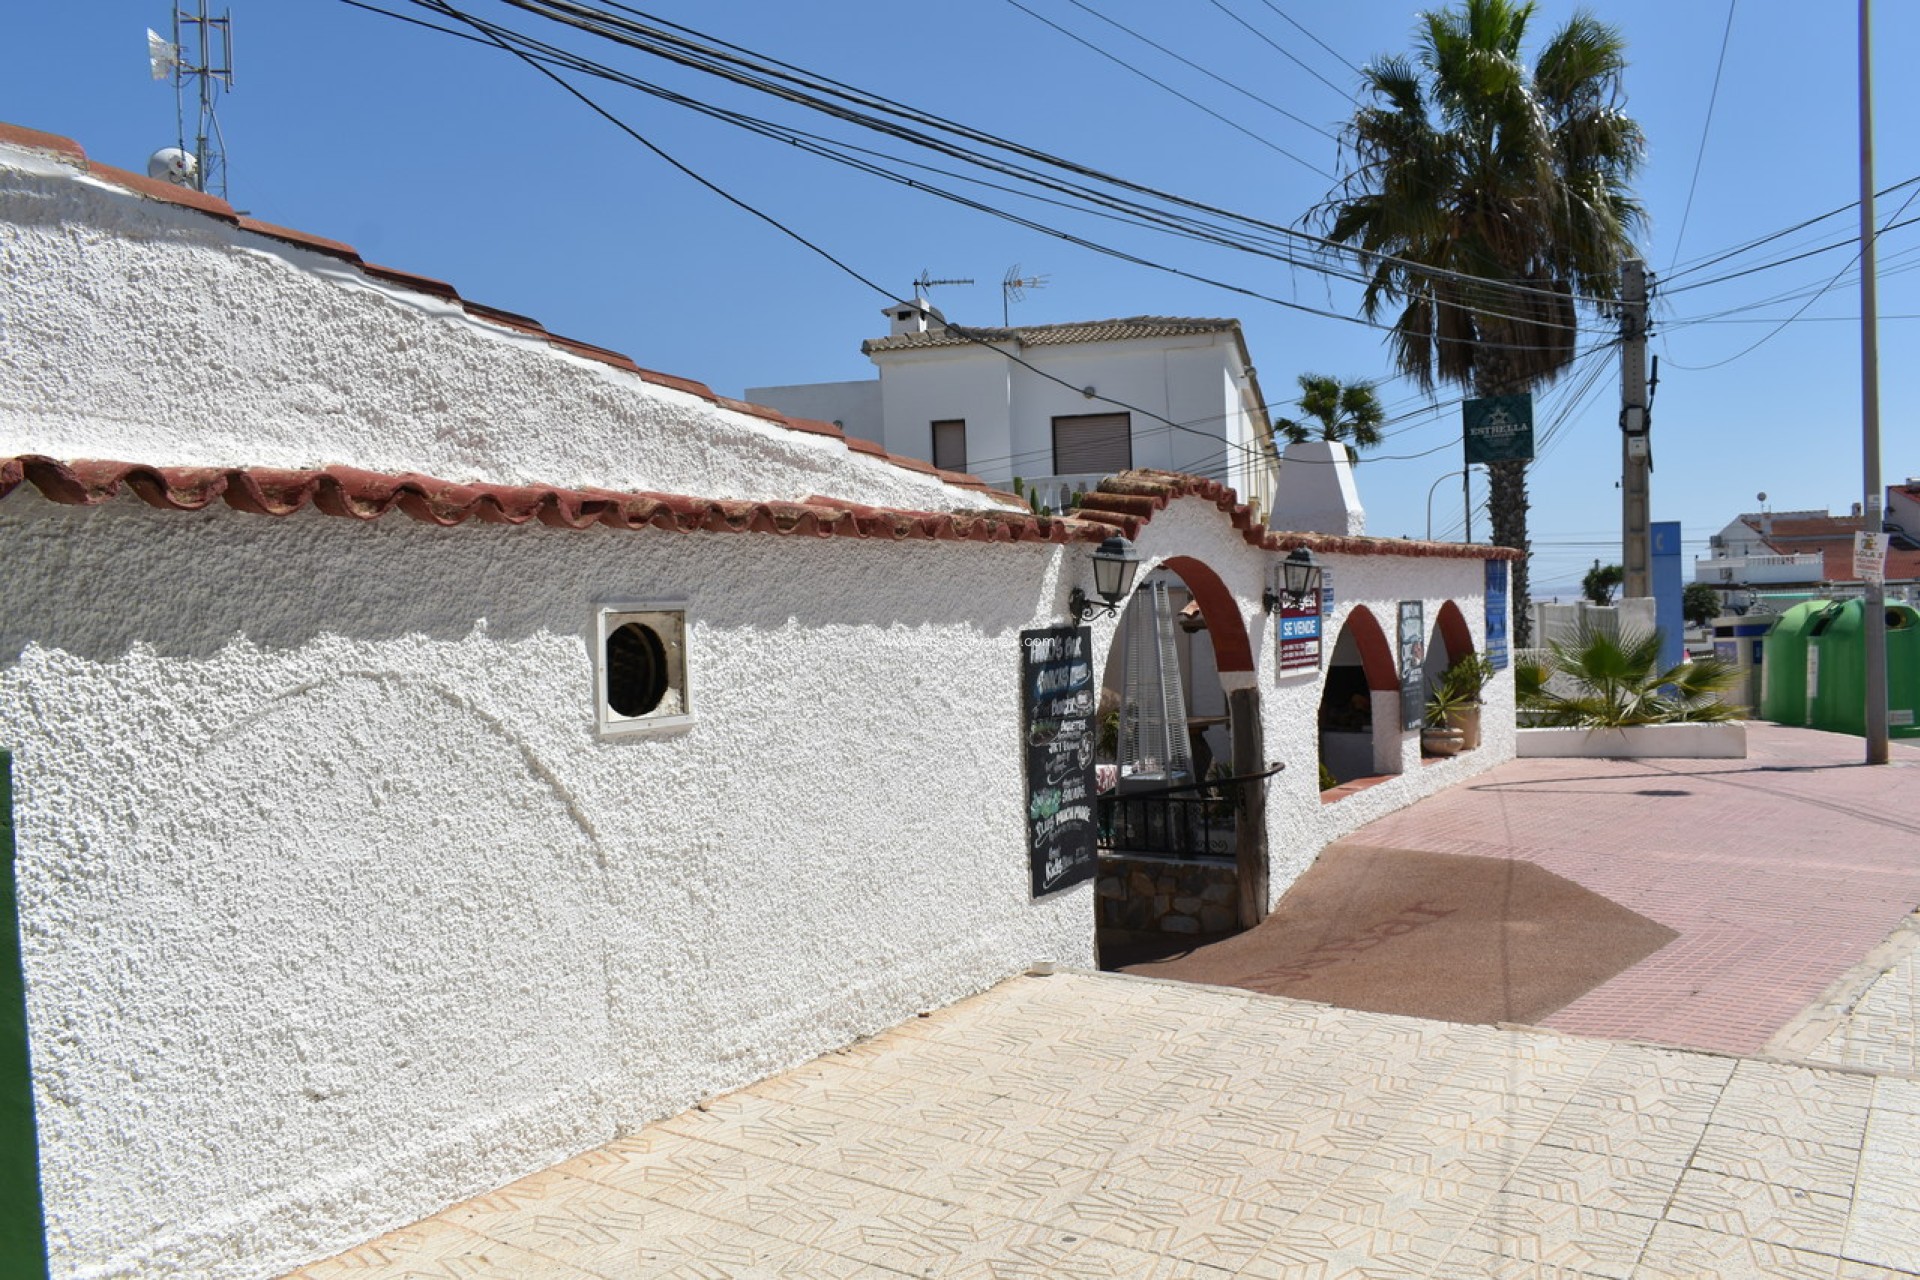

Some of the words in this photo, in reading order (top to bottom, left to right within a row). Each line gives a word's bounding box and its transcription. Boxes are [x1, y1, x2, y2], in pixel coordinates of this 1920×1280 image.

[1470, 423, 1528, 436] ESTRELLA
[1284, 622, 1293, 637] SE
[1294, 619, 1316, 636] VENDE
